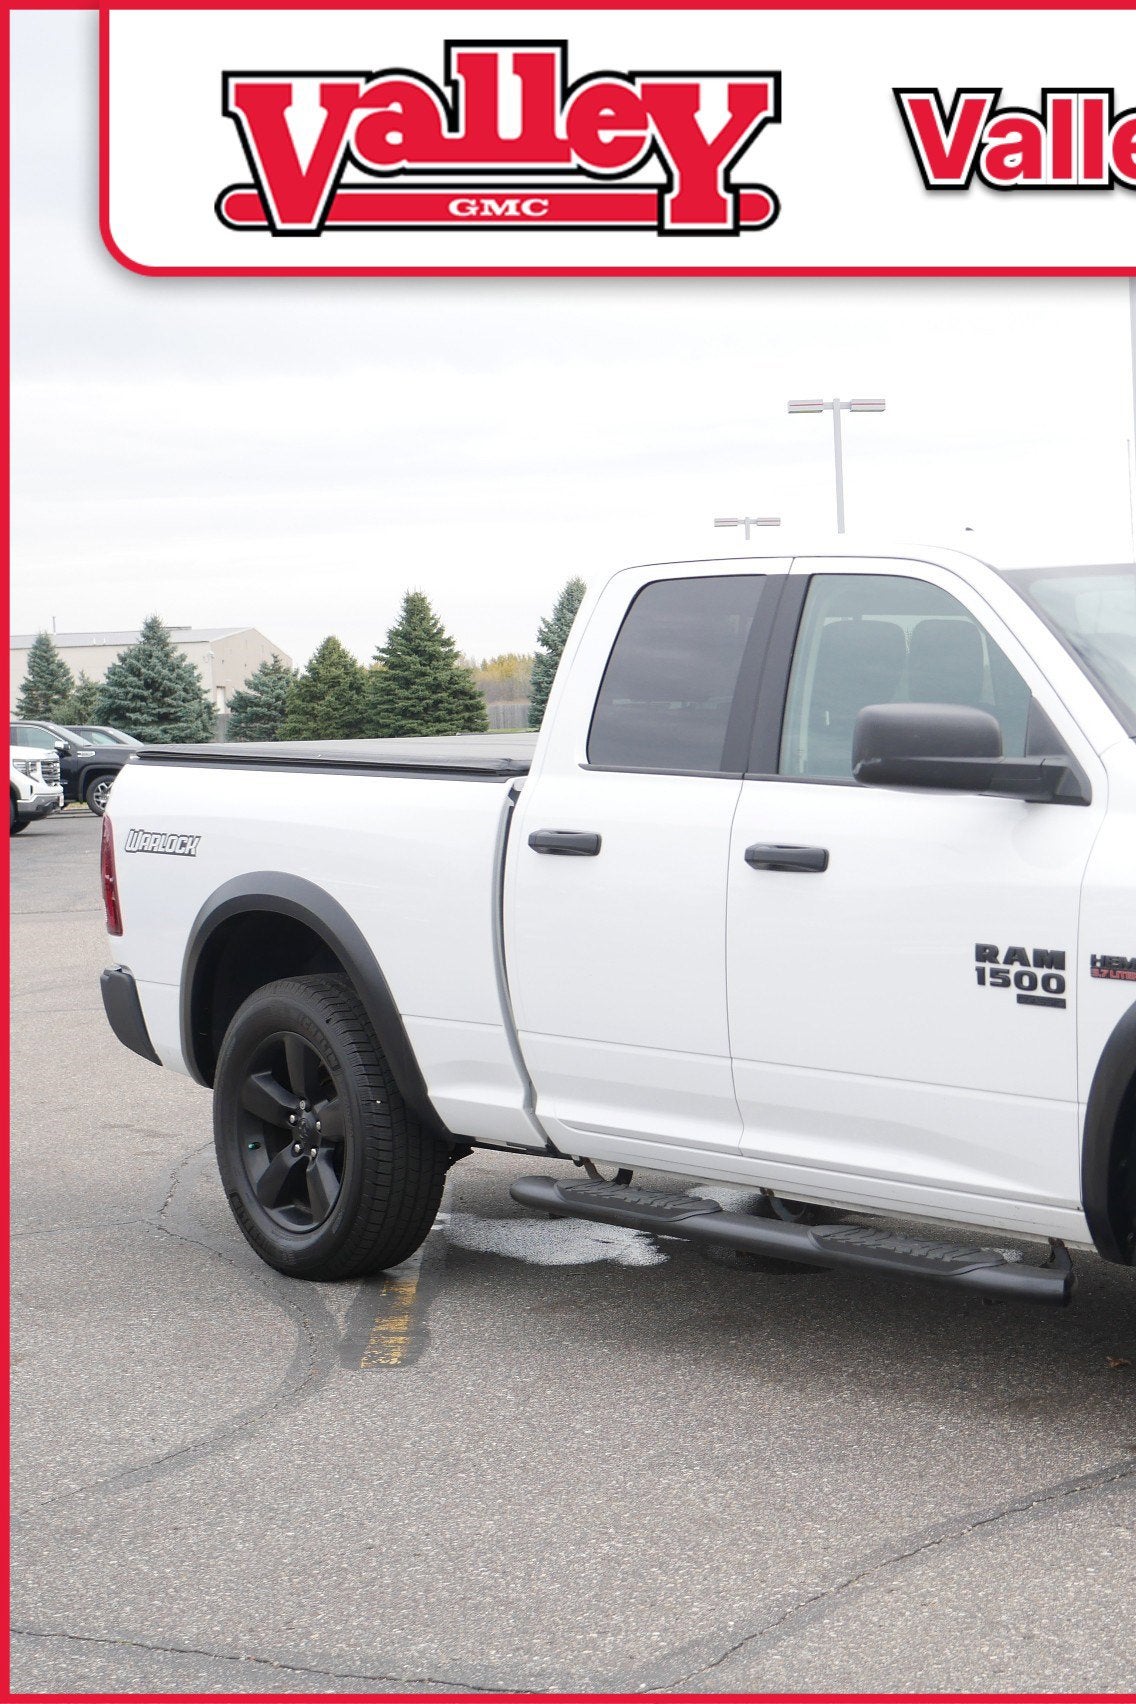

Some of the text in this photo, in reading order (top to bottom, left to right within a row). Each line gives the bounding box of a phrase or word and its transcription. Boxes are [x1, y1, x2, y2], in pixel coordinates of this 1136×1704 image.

[125, 829, 201, 857] WARLOCK
[975, 943, 1066, 971] RAM
[975, 966, 1066, 994] 1500
